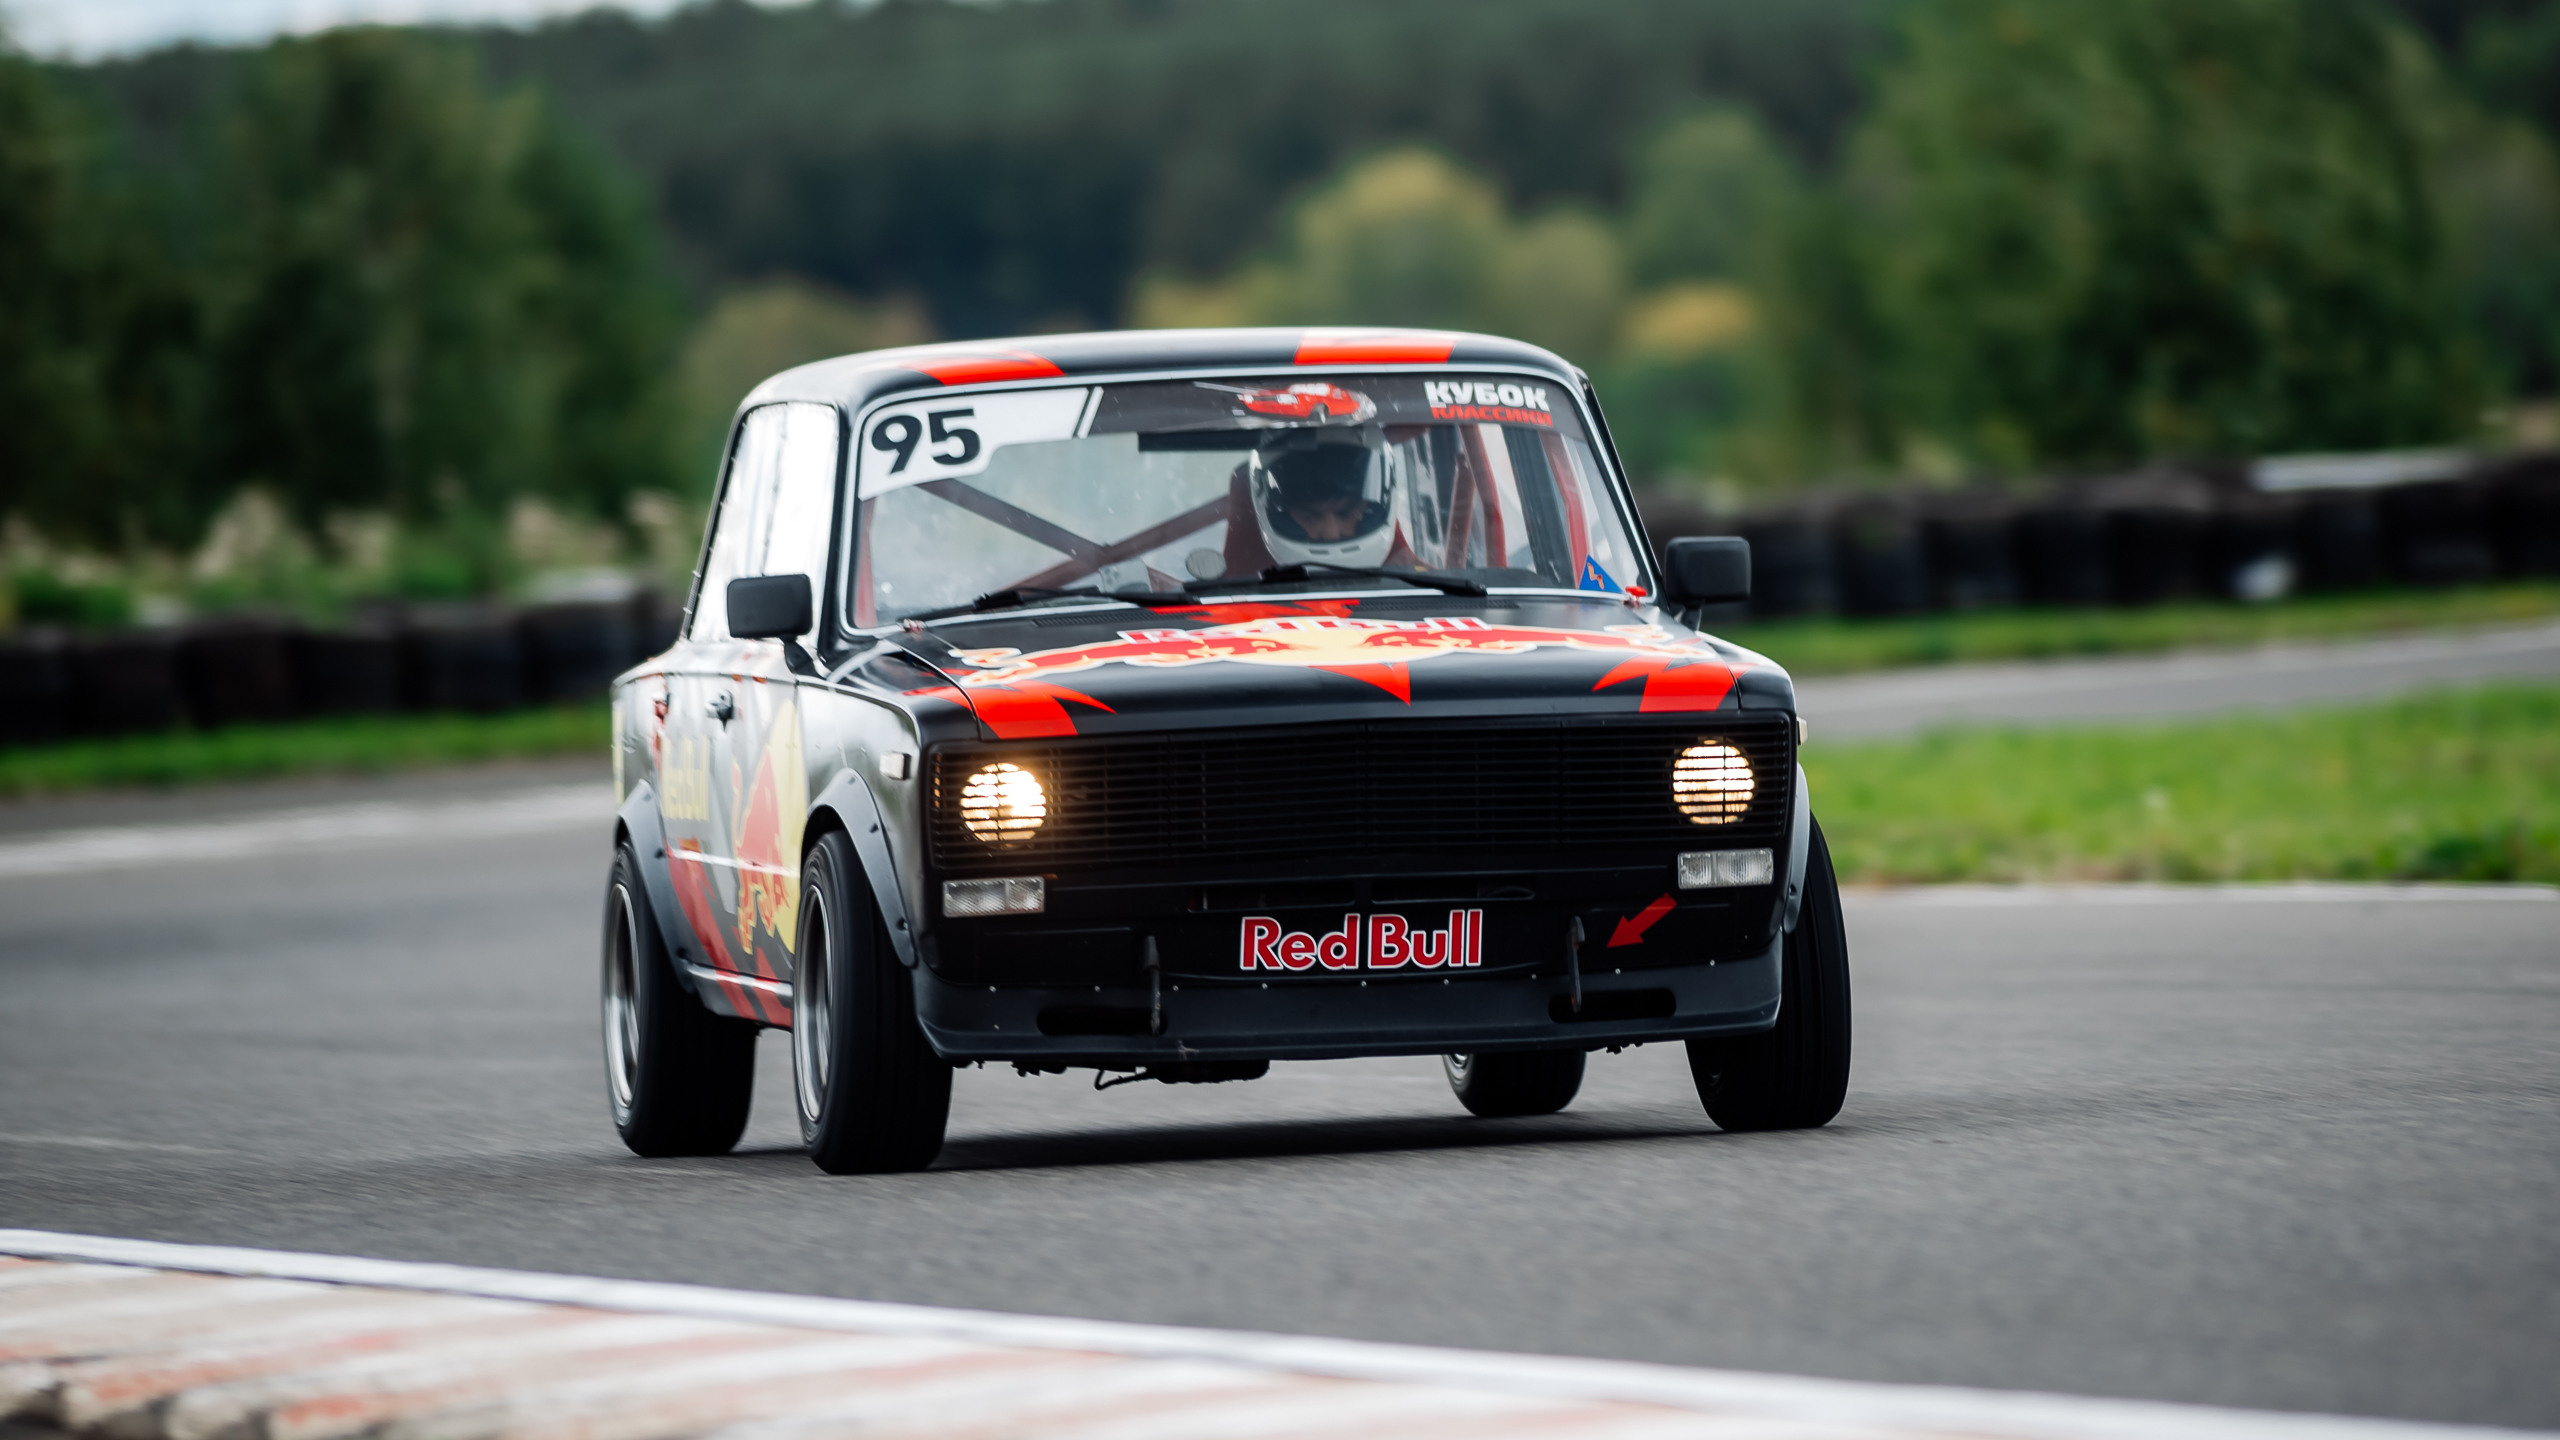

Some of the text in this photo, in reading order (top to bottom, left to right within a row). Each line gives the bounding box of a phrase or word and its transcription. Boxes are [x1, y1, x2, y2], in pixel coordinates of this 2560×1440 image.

[1424, 381, 1549, 411] КУБОК
[1431, 404, 1553, 427] КЛАССИКИ
[871, 408, 981, 474] 95
[1240, 909, 1482, 970] Red Bull
